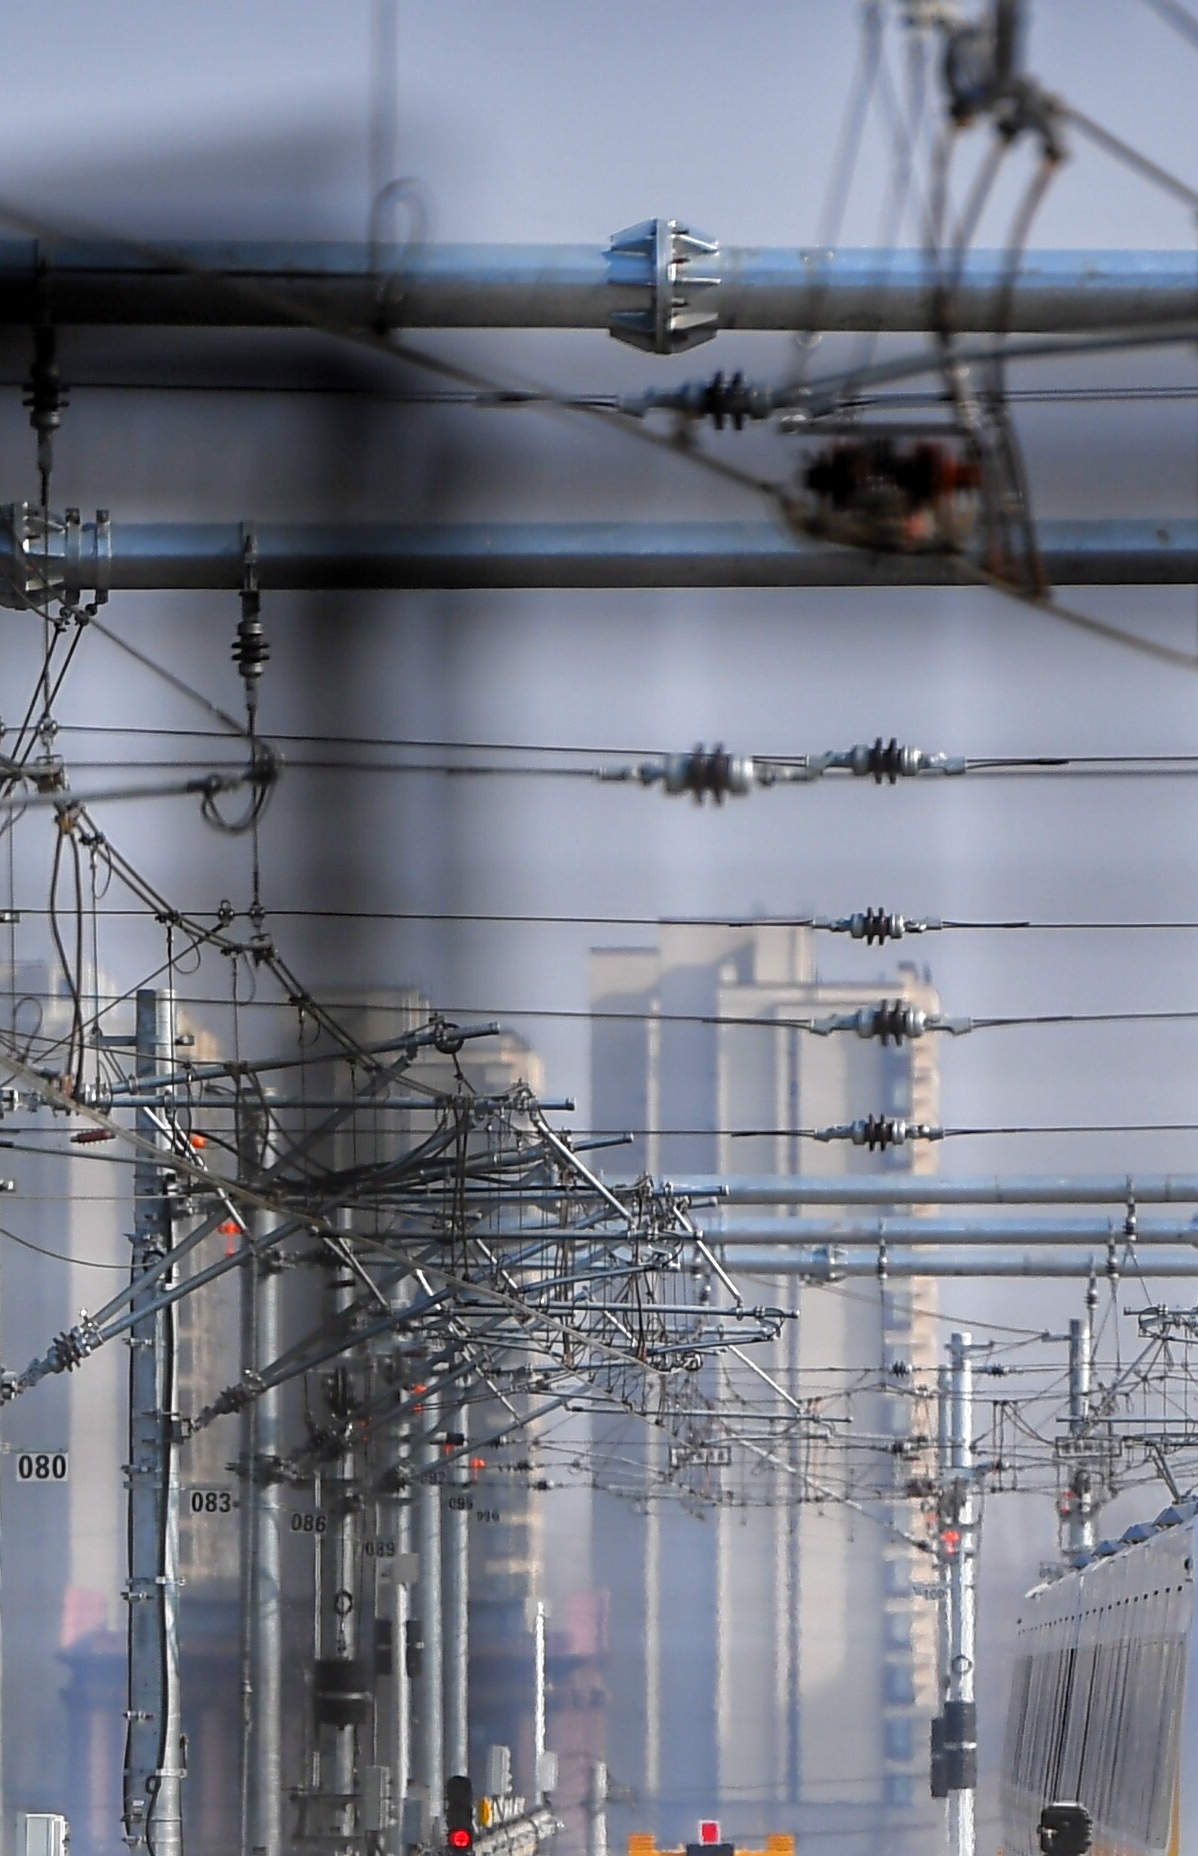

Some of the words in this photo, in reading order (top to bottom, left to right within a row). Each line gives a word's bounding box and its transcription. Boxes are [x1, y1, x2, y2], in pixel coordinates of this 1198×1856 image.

[18, 1454, 67, 1479] 080
[191, 1492, 232, 1513] 083
[291, 1513, 326, 1533] 086
